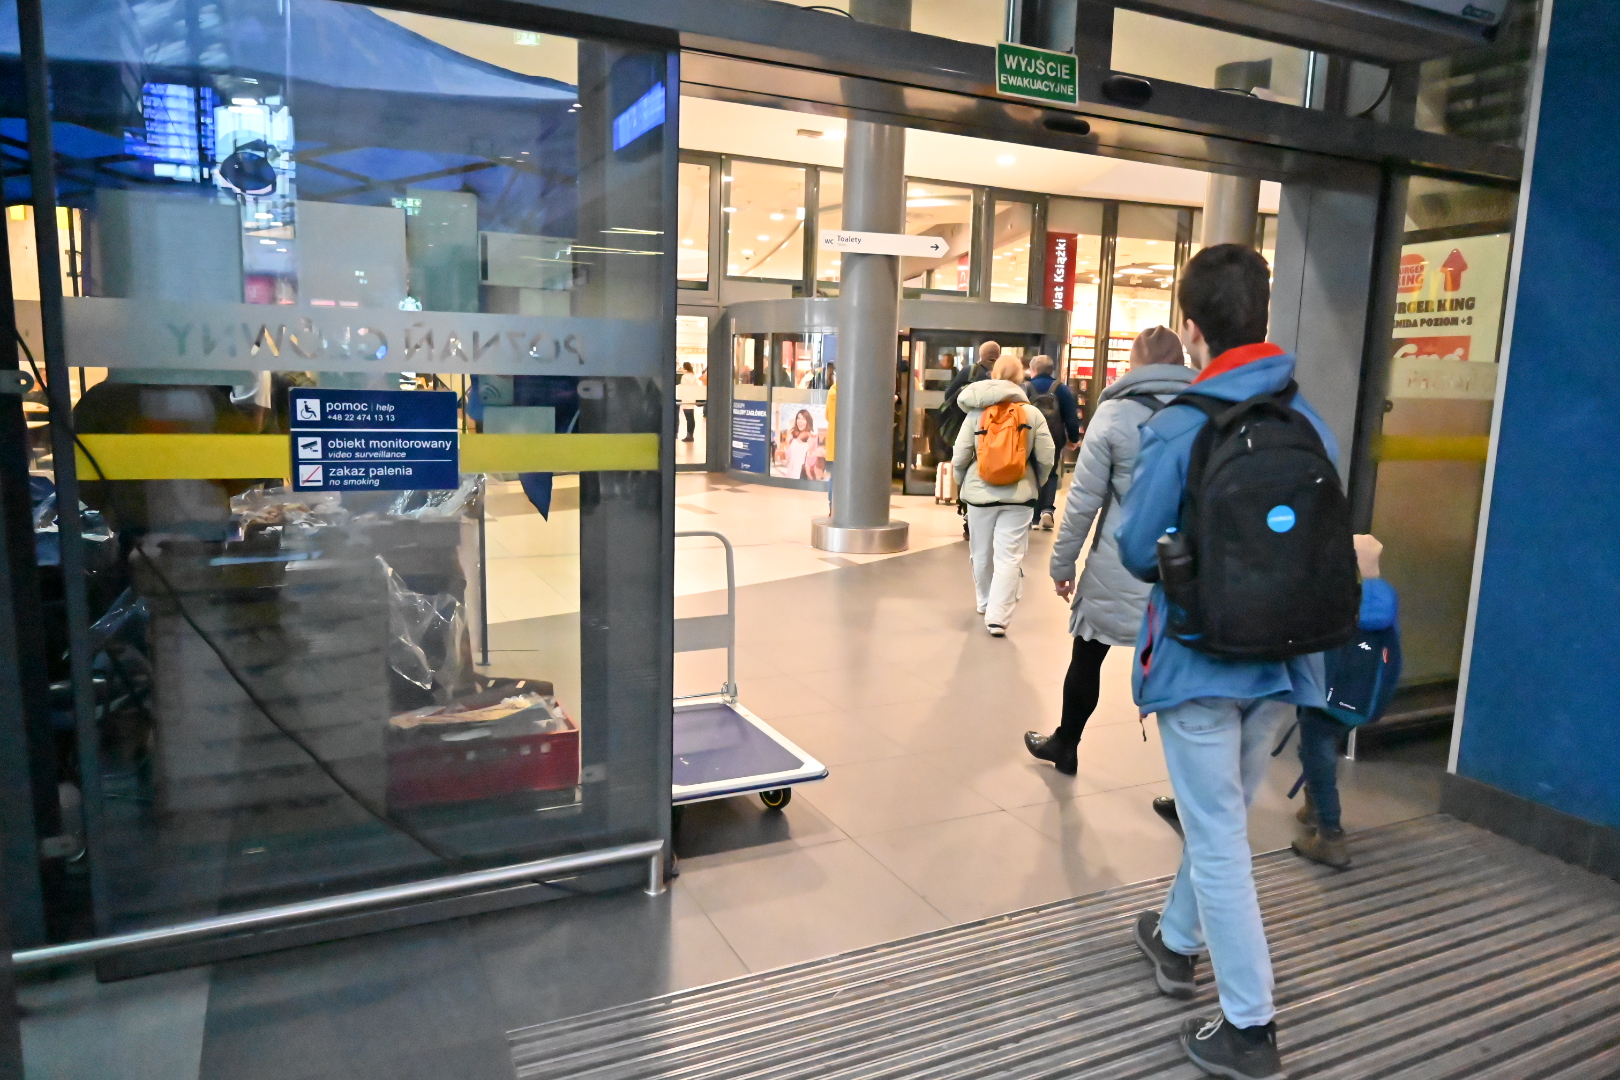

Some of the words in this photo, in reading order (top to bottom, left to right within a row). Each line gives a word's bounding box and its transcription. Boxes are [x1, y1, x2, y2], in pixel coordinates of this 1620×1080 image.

[1004, 53, 1070, 79] WYJŚCIE
[1000, 73, 1074, 95] EWAKUACYJNE
[837, 235, 862, 244] Toalety
[1054, 238, 1068, 282] Książki
[1399, 265, 1425, 274] URGER
[1397, 300, 1434, 314] RGER
[1437, 297, 1476, 312] KING
[1394, 318, 1418, 328] NIDA
[326, 402, 369, 413] pomoc
[376, 403, 395, 412] help
[328, 439, 366, 449] obiekt
[369, 439, 452, 450] monitorowany
[354, 450, 407, 458] surveillance
[329, 466, 366, 476] zakaz
[369, 466, 413, 478] palenia
[343, 478, 380, 487] smoking
